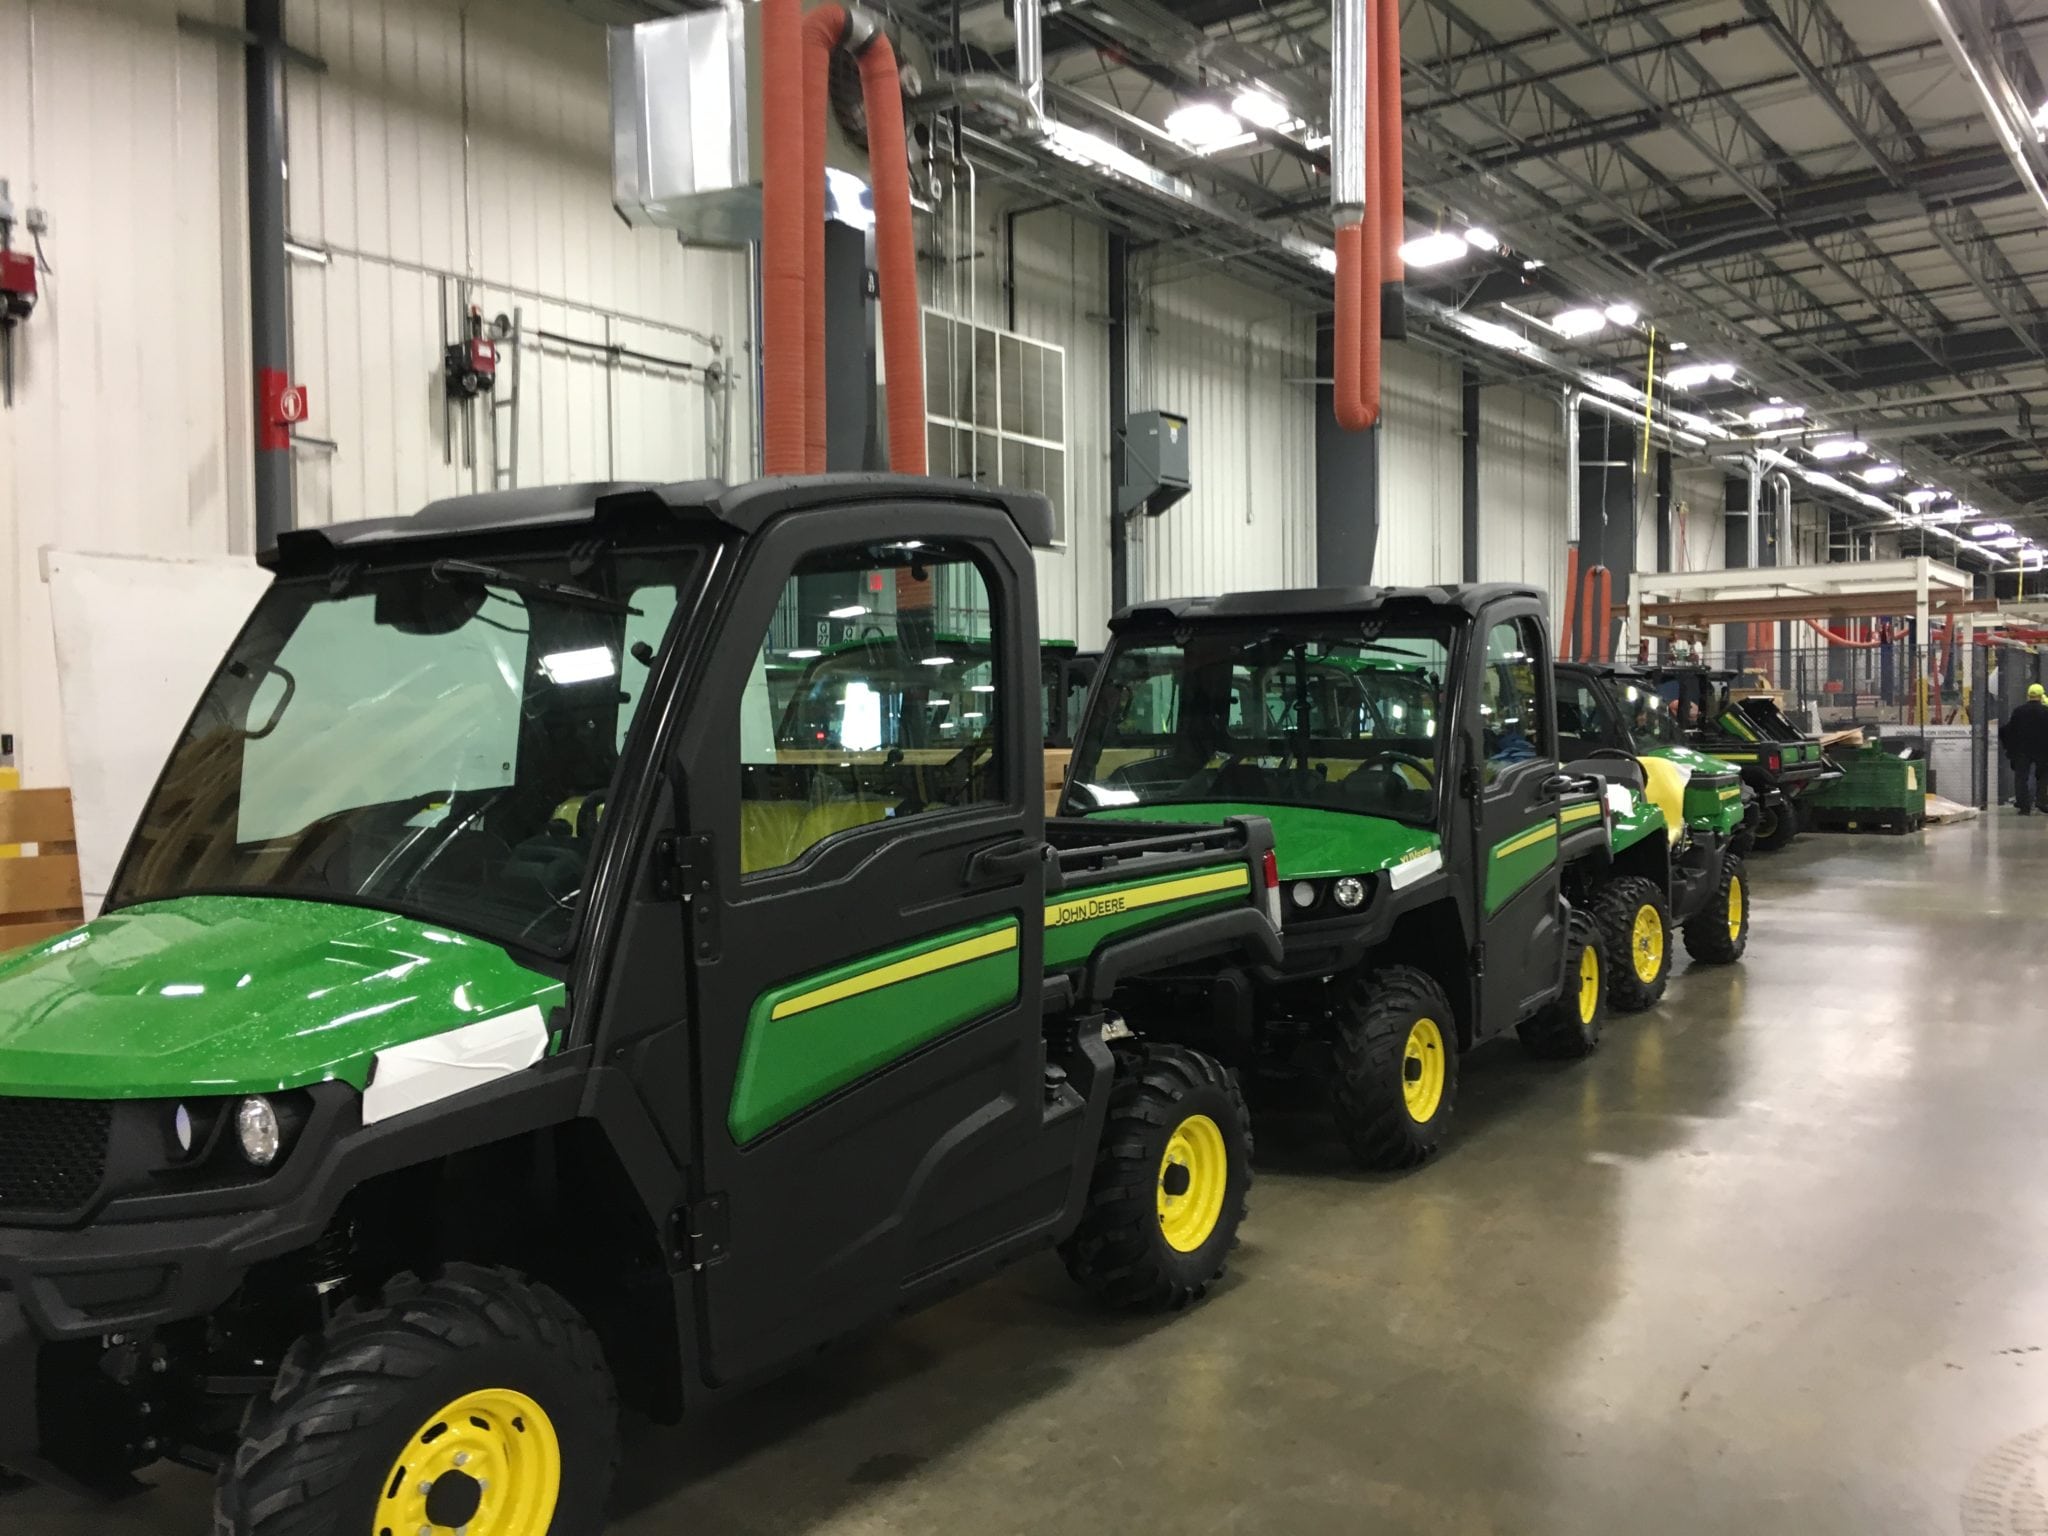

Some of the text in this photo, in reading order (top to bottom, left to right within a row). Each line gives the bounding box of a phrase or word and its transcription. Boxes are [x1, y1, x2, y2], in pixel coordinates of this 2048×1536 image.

[820, 623, 828, 634] Q
[845, 627, 853, 638] Q
[819, 634, 829, 646] 27
[1056, 896, 1126, 924] JOHN DEERE
